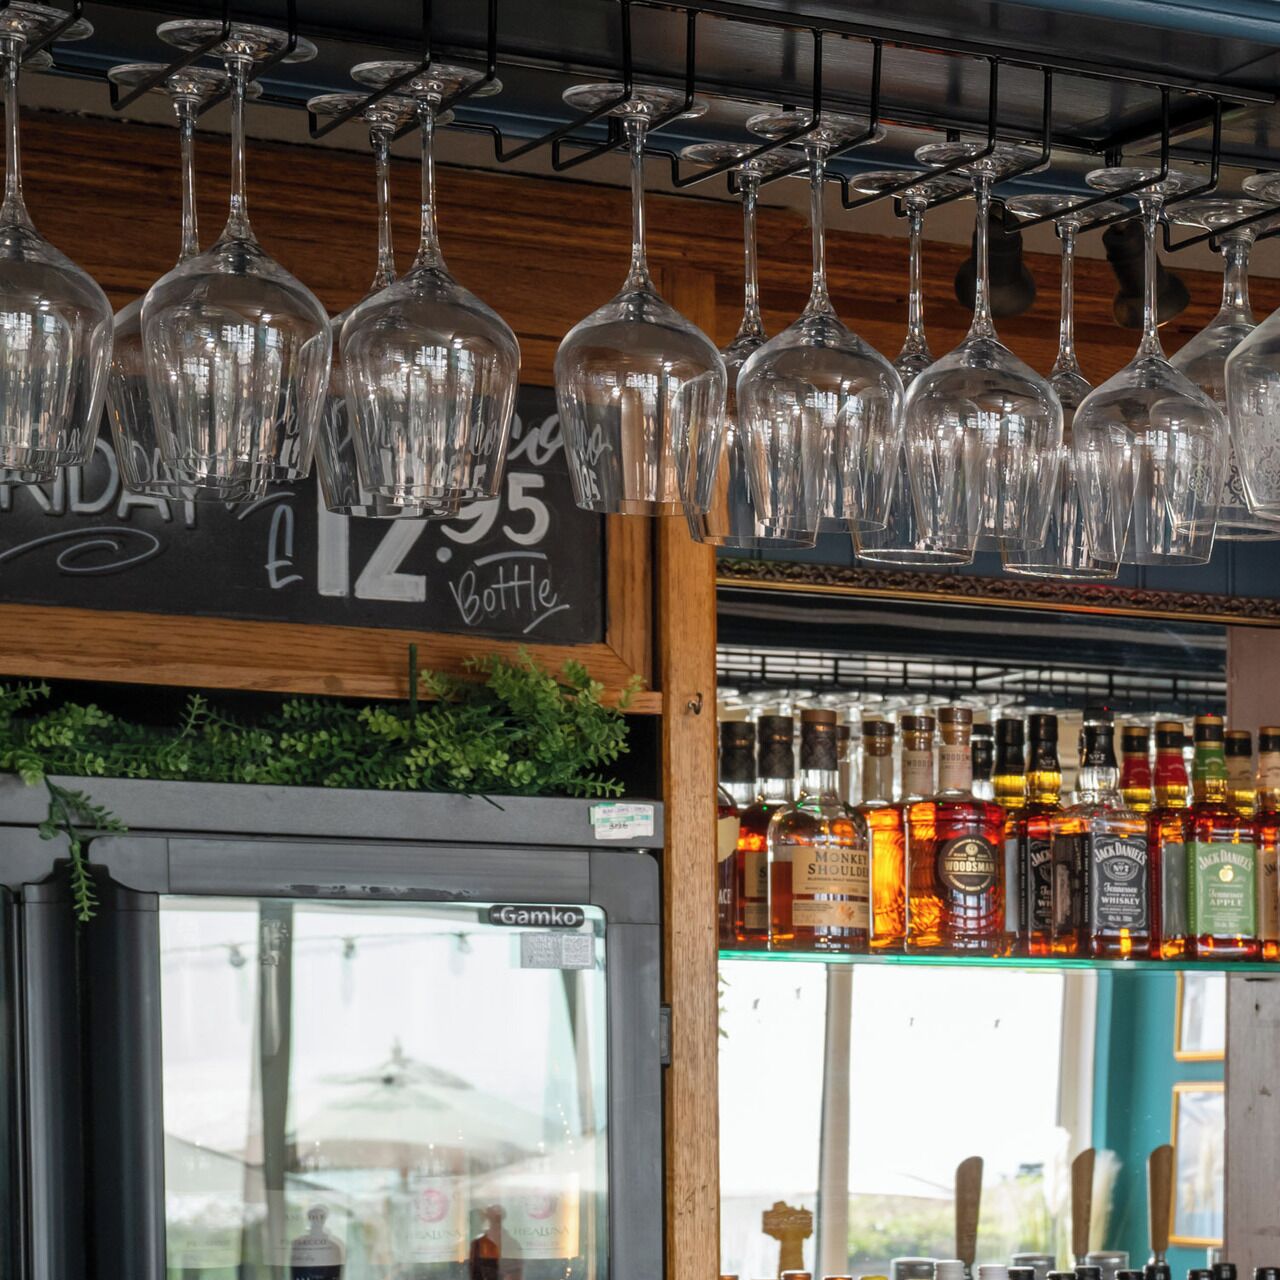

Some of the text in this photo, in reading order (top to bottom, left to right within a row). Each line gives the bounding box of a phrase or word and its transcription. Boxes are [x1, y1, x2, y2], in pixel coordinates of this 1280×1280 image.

[449, 564, 557, 626] Bottle
[944, 860, 995, 873] WOODSMAN
[1101, 896, 1140, 906] WHISKEY
[500, 906, 577, 926] Gamko
